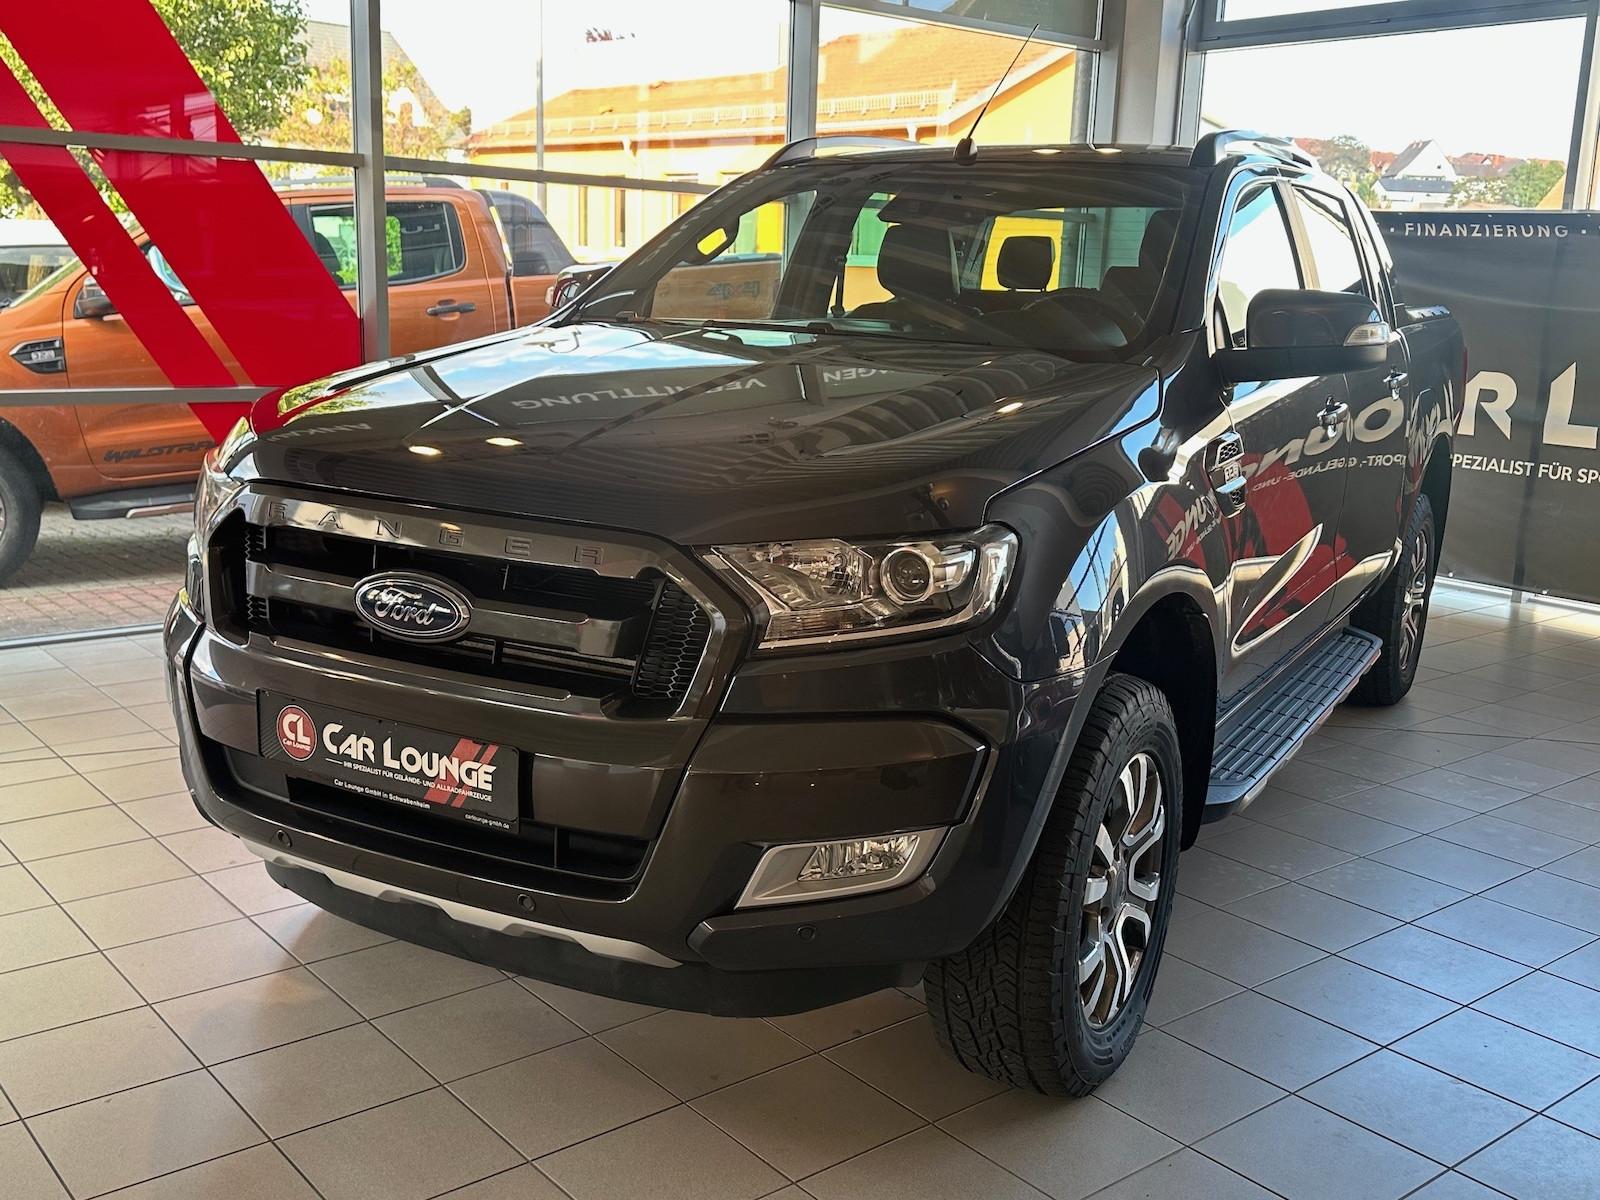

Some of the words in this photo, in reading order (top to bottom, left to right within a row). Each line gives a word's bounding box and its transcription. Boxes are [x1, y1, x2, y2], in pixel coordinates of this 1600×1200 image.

[1405, 223, 1568, 238] FINANZIERUNG
[1450, 453, 1534, 477] PEZIALIST
[1538, 462, 1573, 482] FÜR
[1576, 468, 1600, 484] SP
[268, 500, 605, 566] RANGER
[367, 586, 450, 626] Ford
[283, 713, 311, 746] CL
[323, 723, 375, 764] CAR
[383, 737, 497, 792] LOUNGE
[334, 778, 344, 787] Car
[344, 781, 364, 793] Lounge
[365, 787, 382, 797] GmbH
[382, 791, 389, 799] in
[389, 794, 431, 809] Schwabenheim
[343, 761, 353, 769] IHR
[353, 763, 381, 776] SPEZIALIST
[382, 769, 394, 778] FÜR
[422, 780, 436, 789] UND
[436, 783, 492, 802] ALLRADFAHRZEUGE
